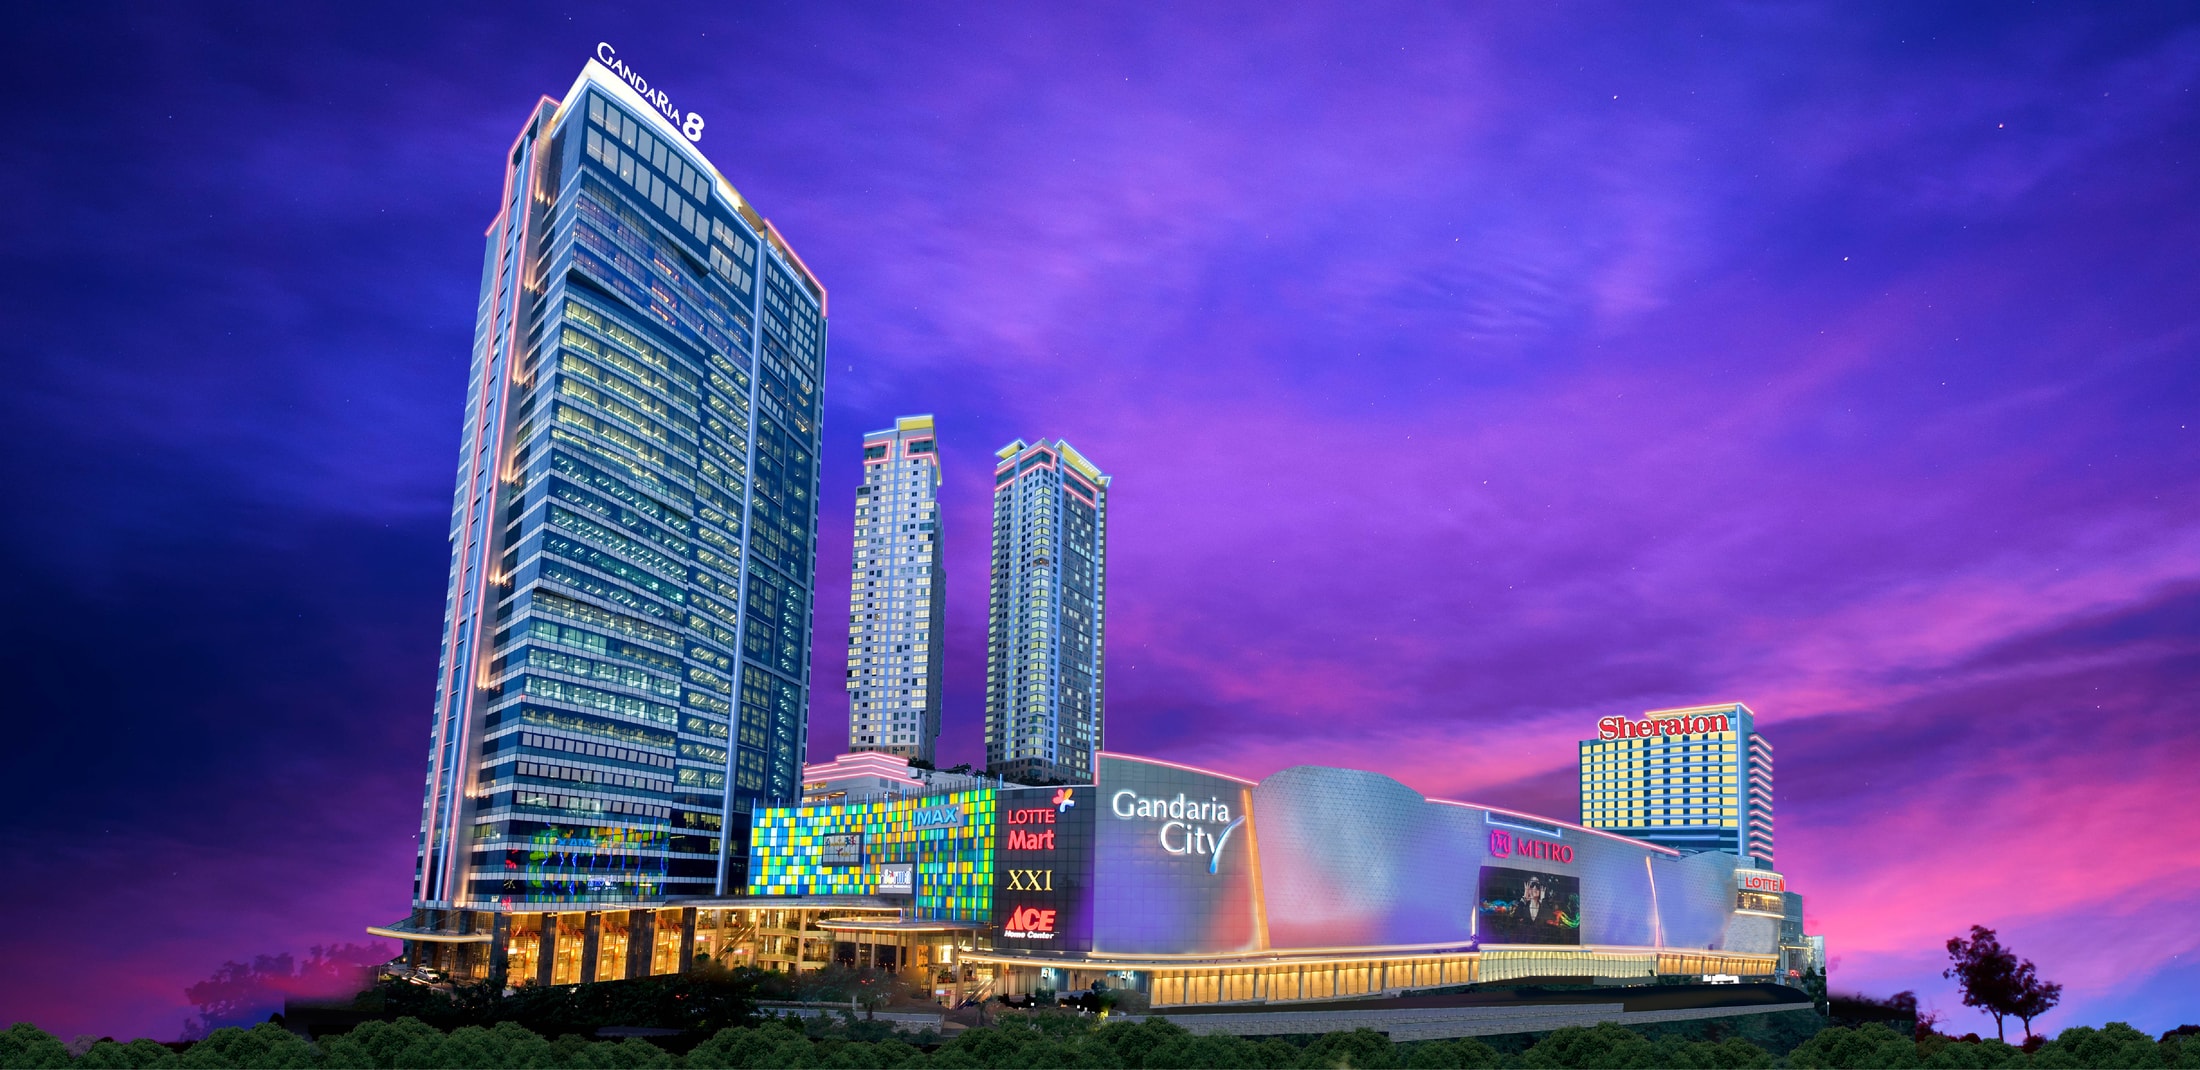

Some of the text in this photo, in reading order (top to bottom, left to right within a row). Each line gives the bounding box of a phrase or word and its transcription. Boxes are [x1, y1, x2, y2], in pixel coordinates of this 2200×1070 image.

[682, 112, 705, 142] 8
[1599, 713, 1729, 740] Sheraton
[913, 807, 957, 826] IMAX
[1008, 808, 1056, 824] LOTTE
[1112, 790, 1230, 823] Gandaria
[1007, 829, 1055, 850] Mart
[1160, 815, 1246, 875] City
[1517, 837, 1574, 864] METRO
[1006, 869, 1053, 891] XXI
[1005, 905, 1057, 931] ACE
[1004, 929, 1055, 939] Home Center
